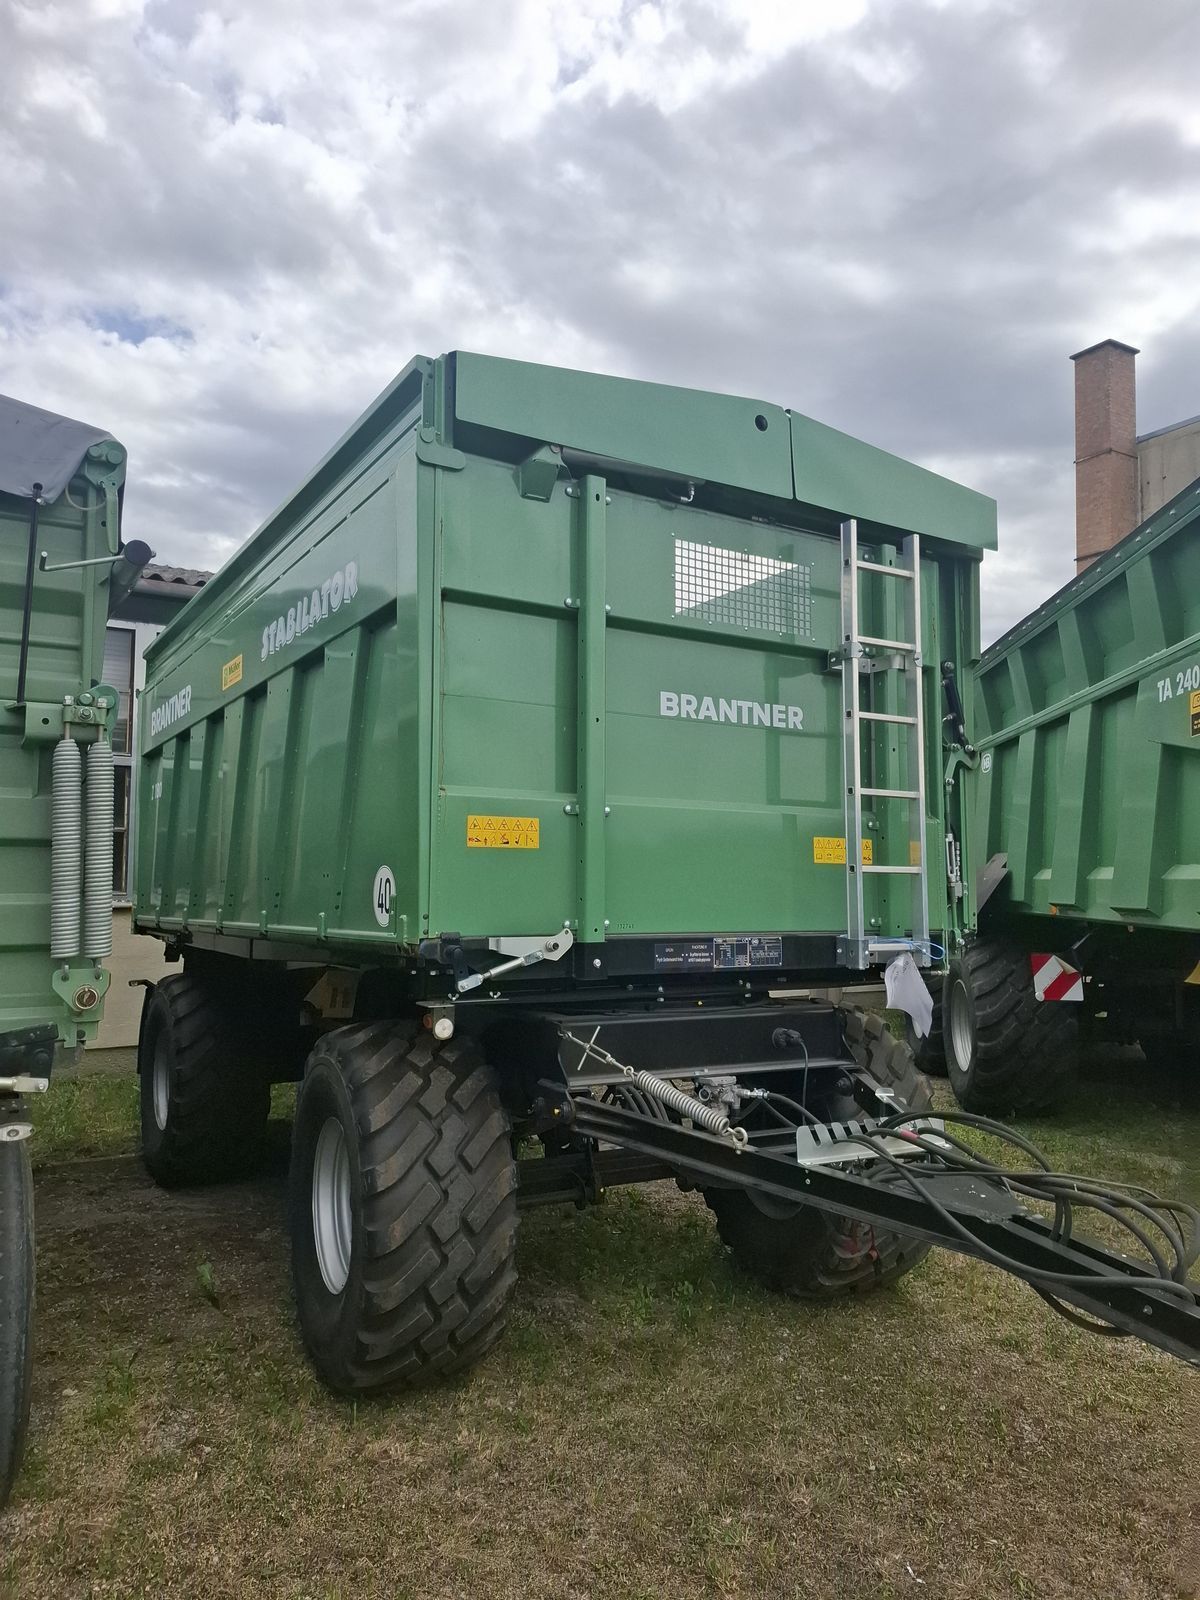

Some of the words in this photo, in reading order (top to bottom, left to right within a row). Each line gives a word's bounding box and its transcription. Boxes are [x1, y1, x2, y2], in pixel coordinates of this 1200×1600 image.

[261, 561, 358, 662] STABILATOR
[1157, 677, 1173, 703] TA
[1176, 664, 1200, 696] 240
[151, 684, 192, 737] BRANTNER
[660, 691, 804, 730] BRANTNER
[377, 877, 391, 914] 40
